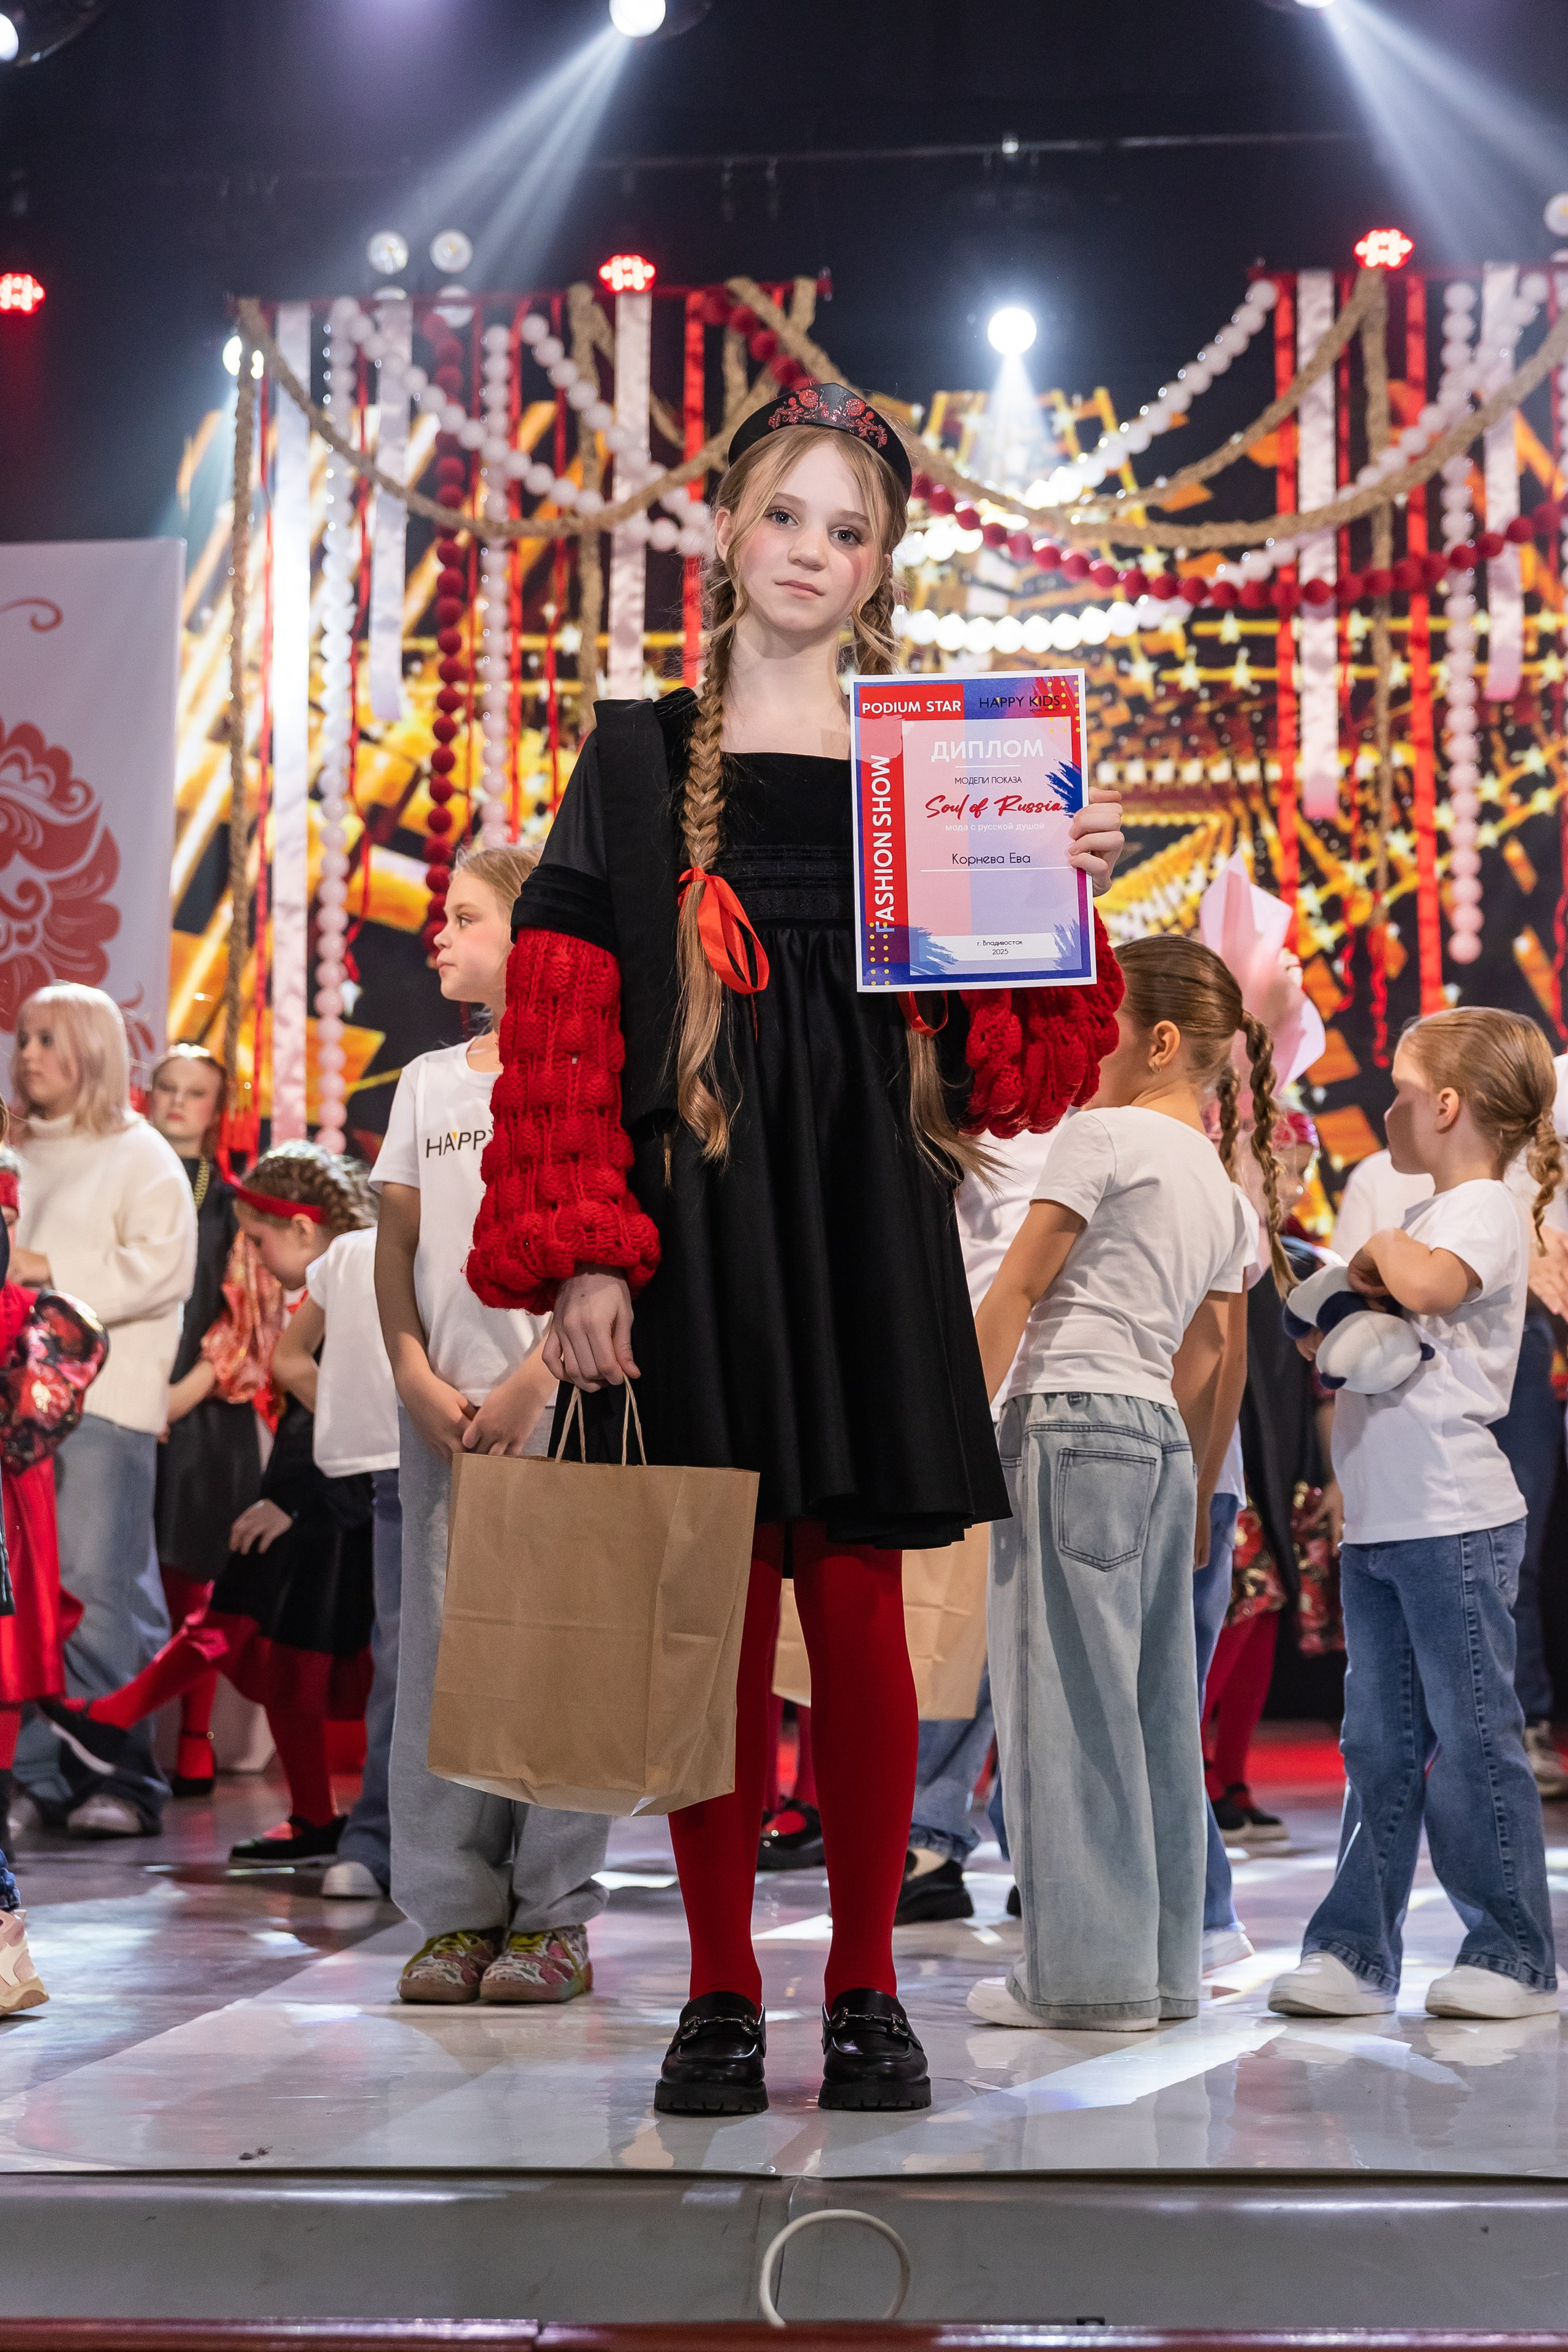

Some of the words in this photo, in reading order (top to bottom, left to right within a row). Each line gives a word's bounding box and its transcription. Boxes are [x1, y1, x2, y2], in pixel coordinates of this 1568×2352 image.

[862, 701, 921, 714] PODIUM
[926, 700, 961, 712] STAR
[979, 696, 1025, 709] HAPPY
[1029, 695, 1060, 707] KIDS
[930, 739, 1044, 763] ДИПЛОМ
[870, 755, 892, 826] SHOW
[925, 794, 970, 820] Soul
[969, 797, 989, 818] of
[993, 795, 1063, 816] Russia
[978, 822, 1014, 832] русской
[1016, 821, 1045, 831] душой
[952, 853, 1005, 866] Корнева
[1009, 852, 1031, 864] Ева
[873, 832, 895, 933] FASHION
